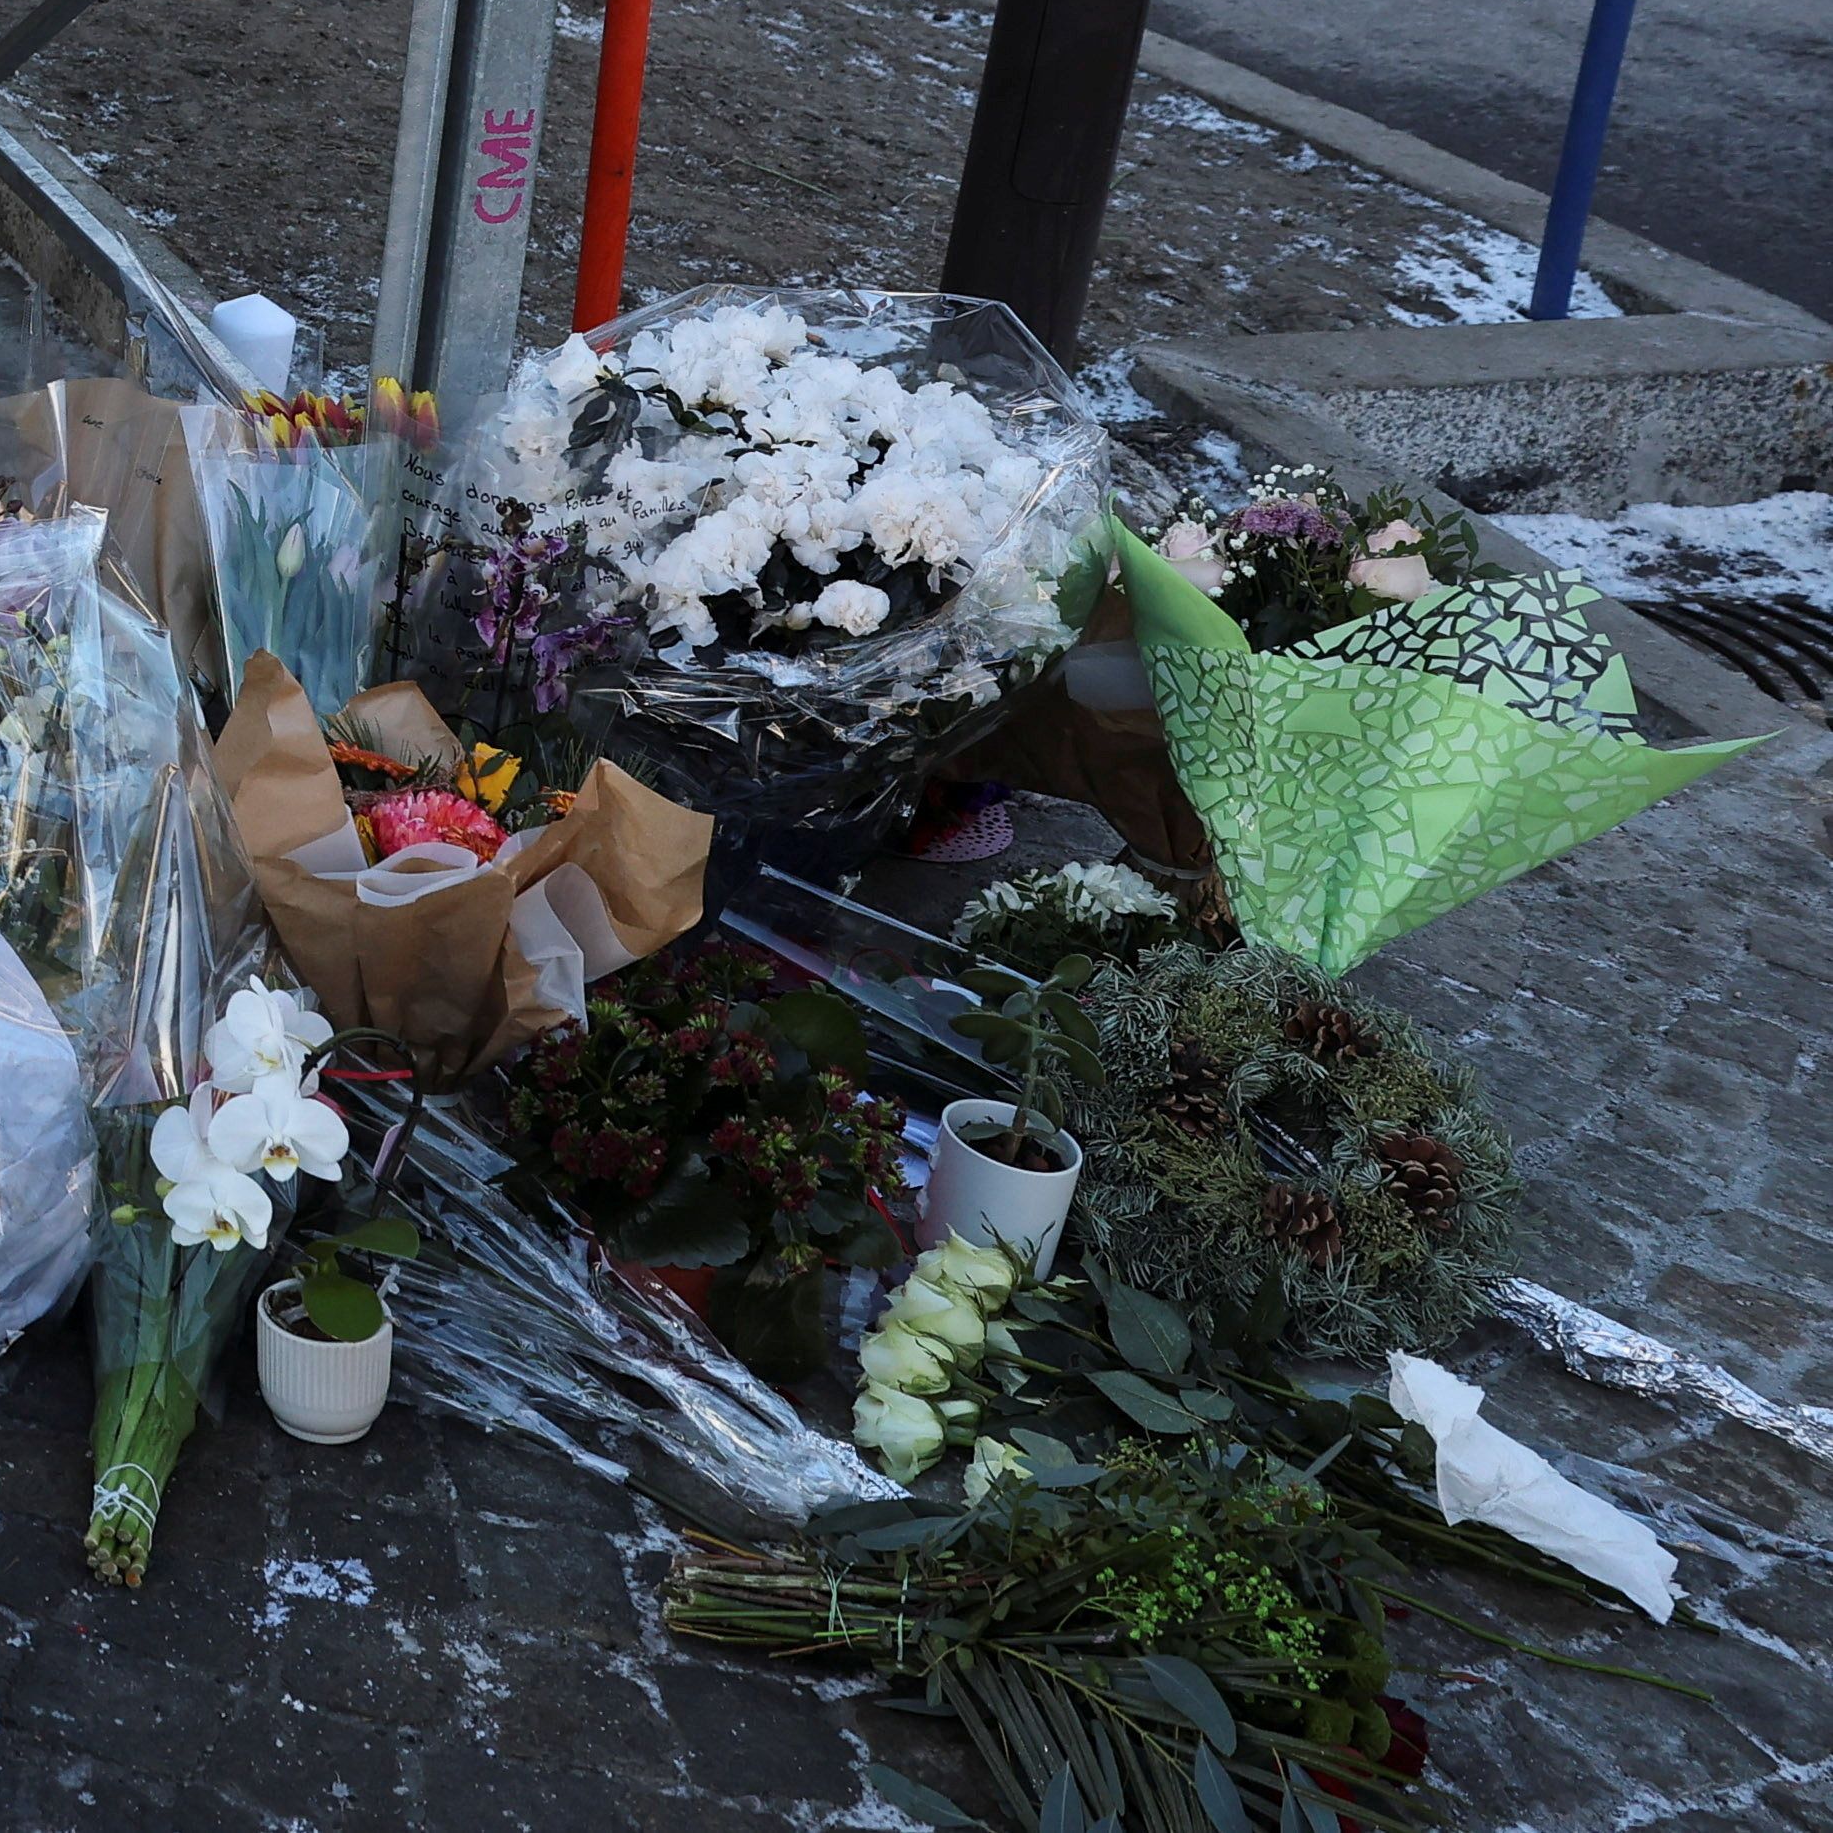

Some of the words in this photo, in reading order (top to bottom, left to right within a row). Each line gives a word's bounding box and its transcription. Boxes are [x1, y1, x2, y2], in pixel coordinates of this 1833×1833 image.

[403, 453, 445, 486] Nous
[564, 489, 606, 511] force
[617, 488, 633, 502] et
[402, 489, 462, 528] courage
[599, 515, 617, 529] au
[428, 624, 442, 645] la
